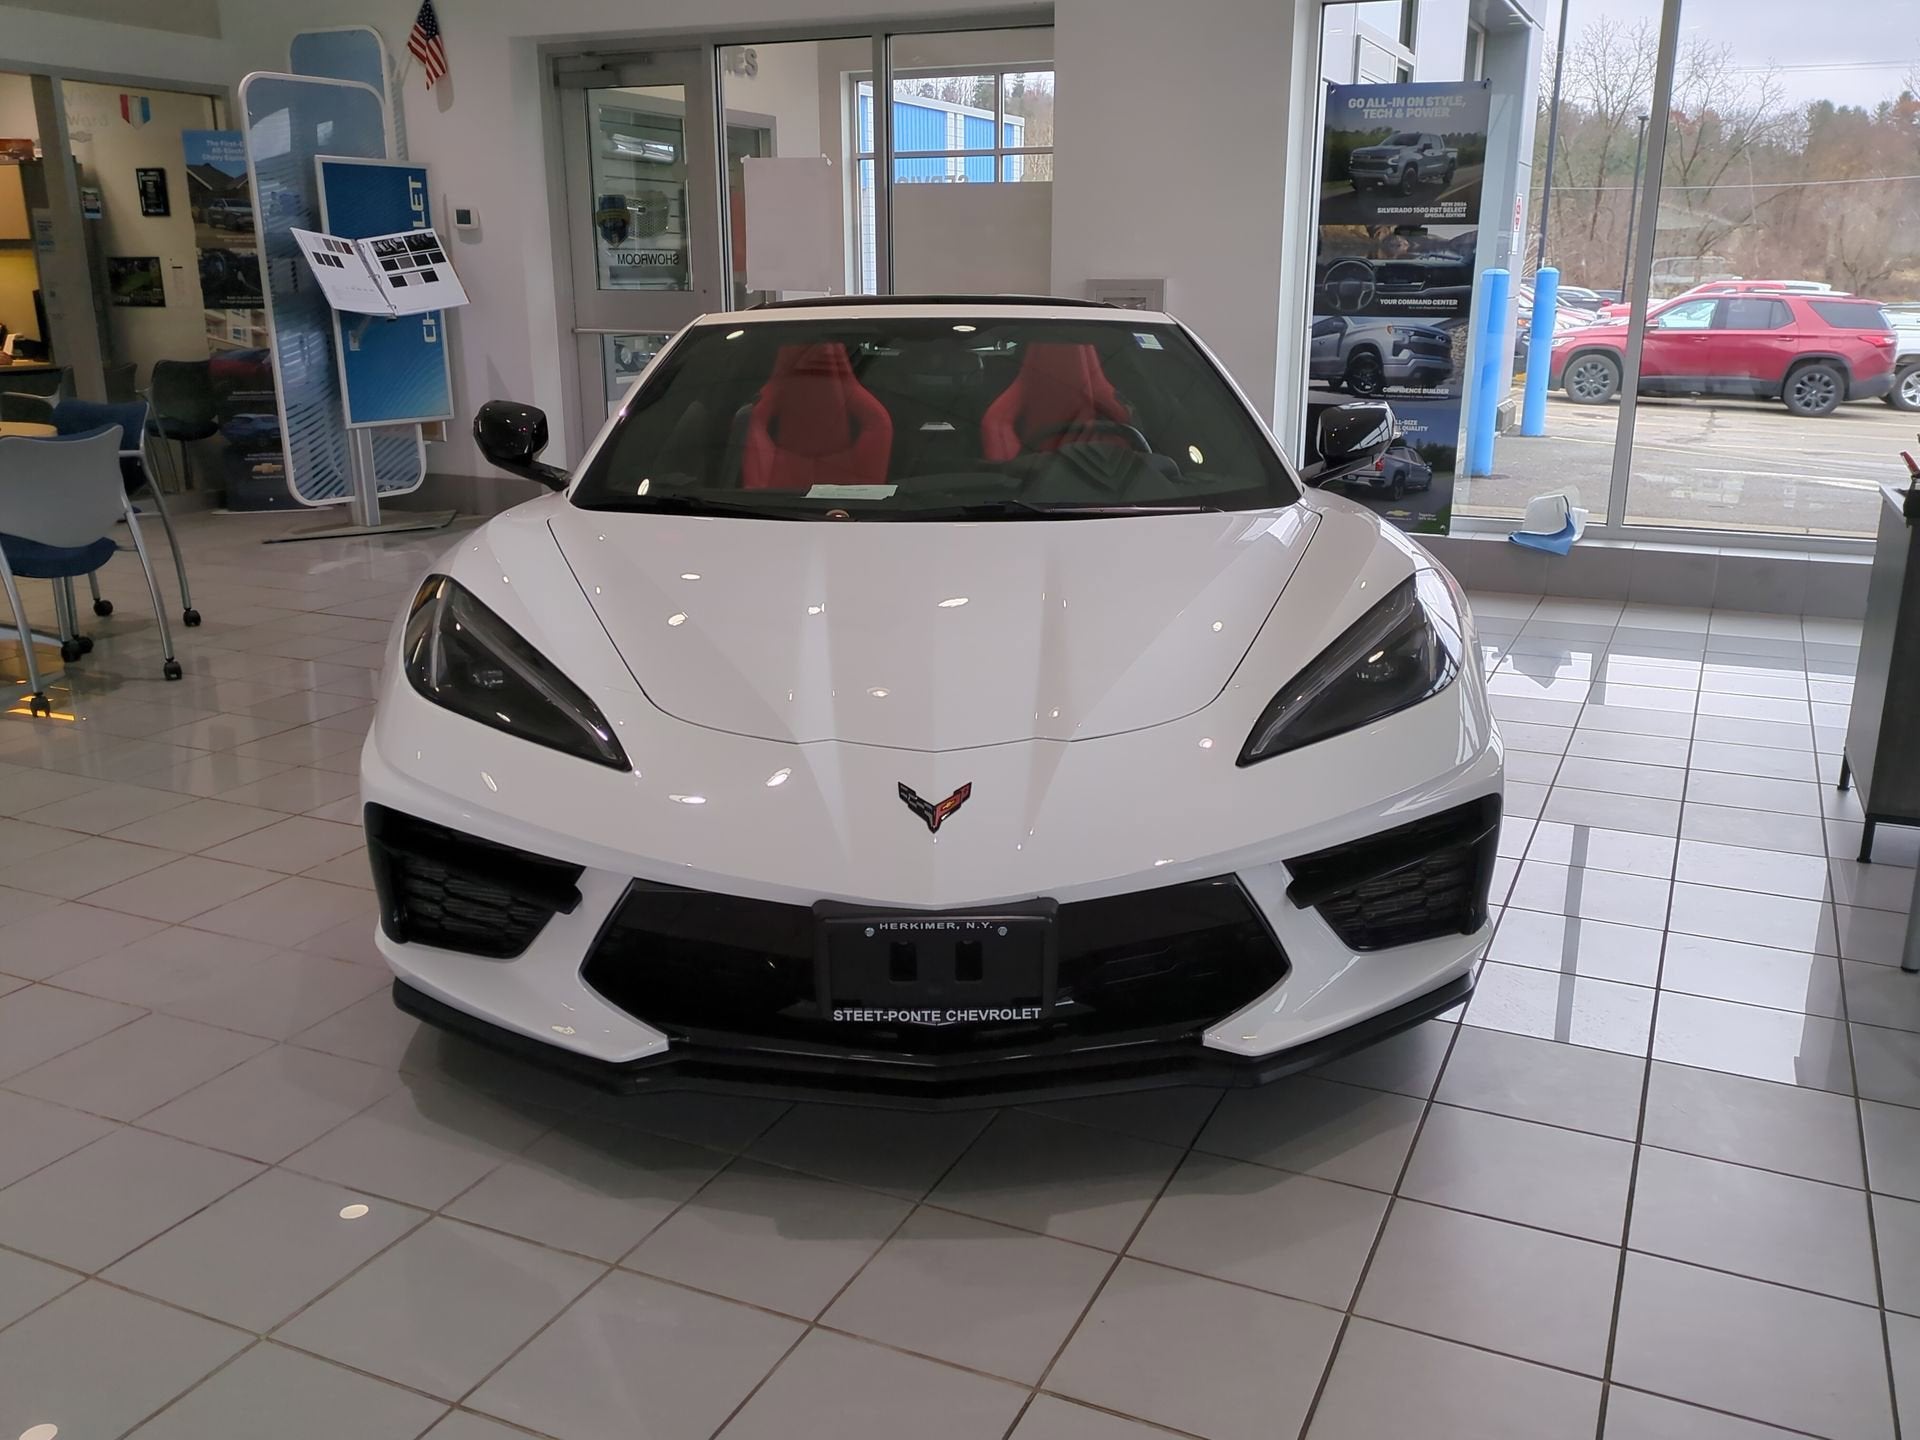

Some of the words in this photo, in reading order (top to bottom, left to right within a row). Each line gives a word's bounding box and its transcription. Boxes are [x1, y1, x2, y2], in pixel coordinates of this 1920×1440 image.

[1348, 98, 1365, 109] GO
[1366, 97, 1405, 108] ALL-IN
[1406, 96, 1425, 107] ON
[1426, 95, 1467, 108] STYLE,
[1363, 108, 1393, 119] TECH
[1394, 108, 1405, 118] &
[1406, 107, 1451, 118] POWER
[880, 922, 960, 931] HERKIMER,
[966, 921, 993, 930] N.Y.
[833, 1010, 941, 1023] STEET-PONTE
[946, 1008, 1042, 1022] CHEVROLET
